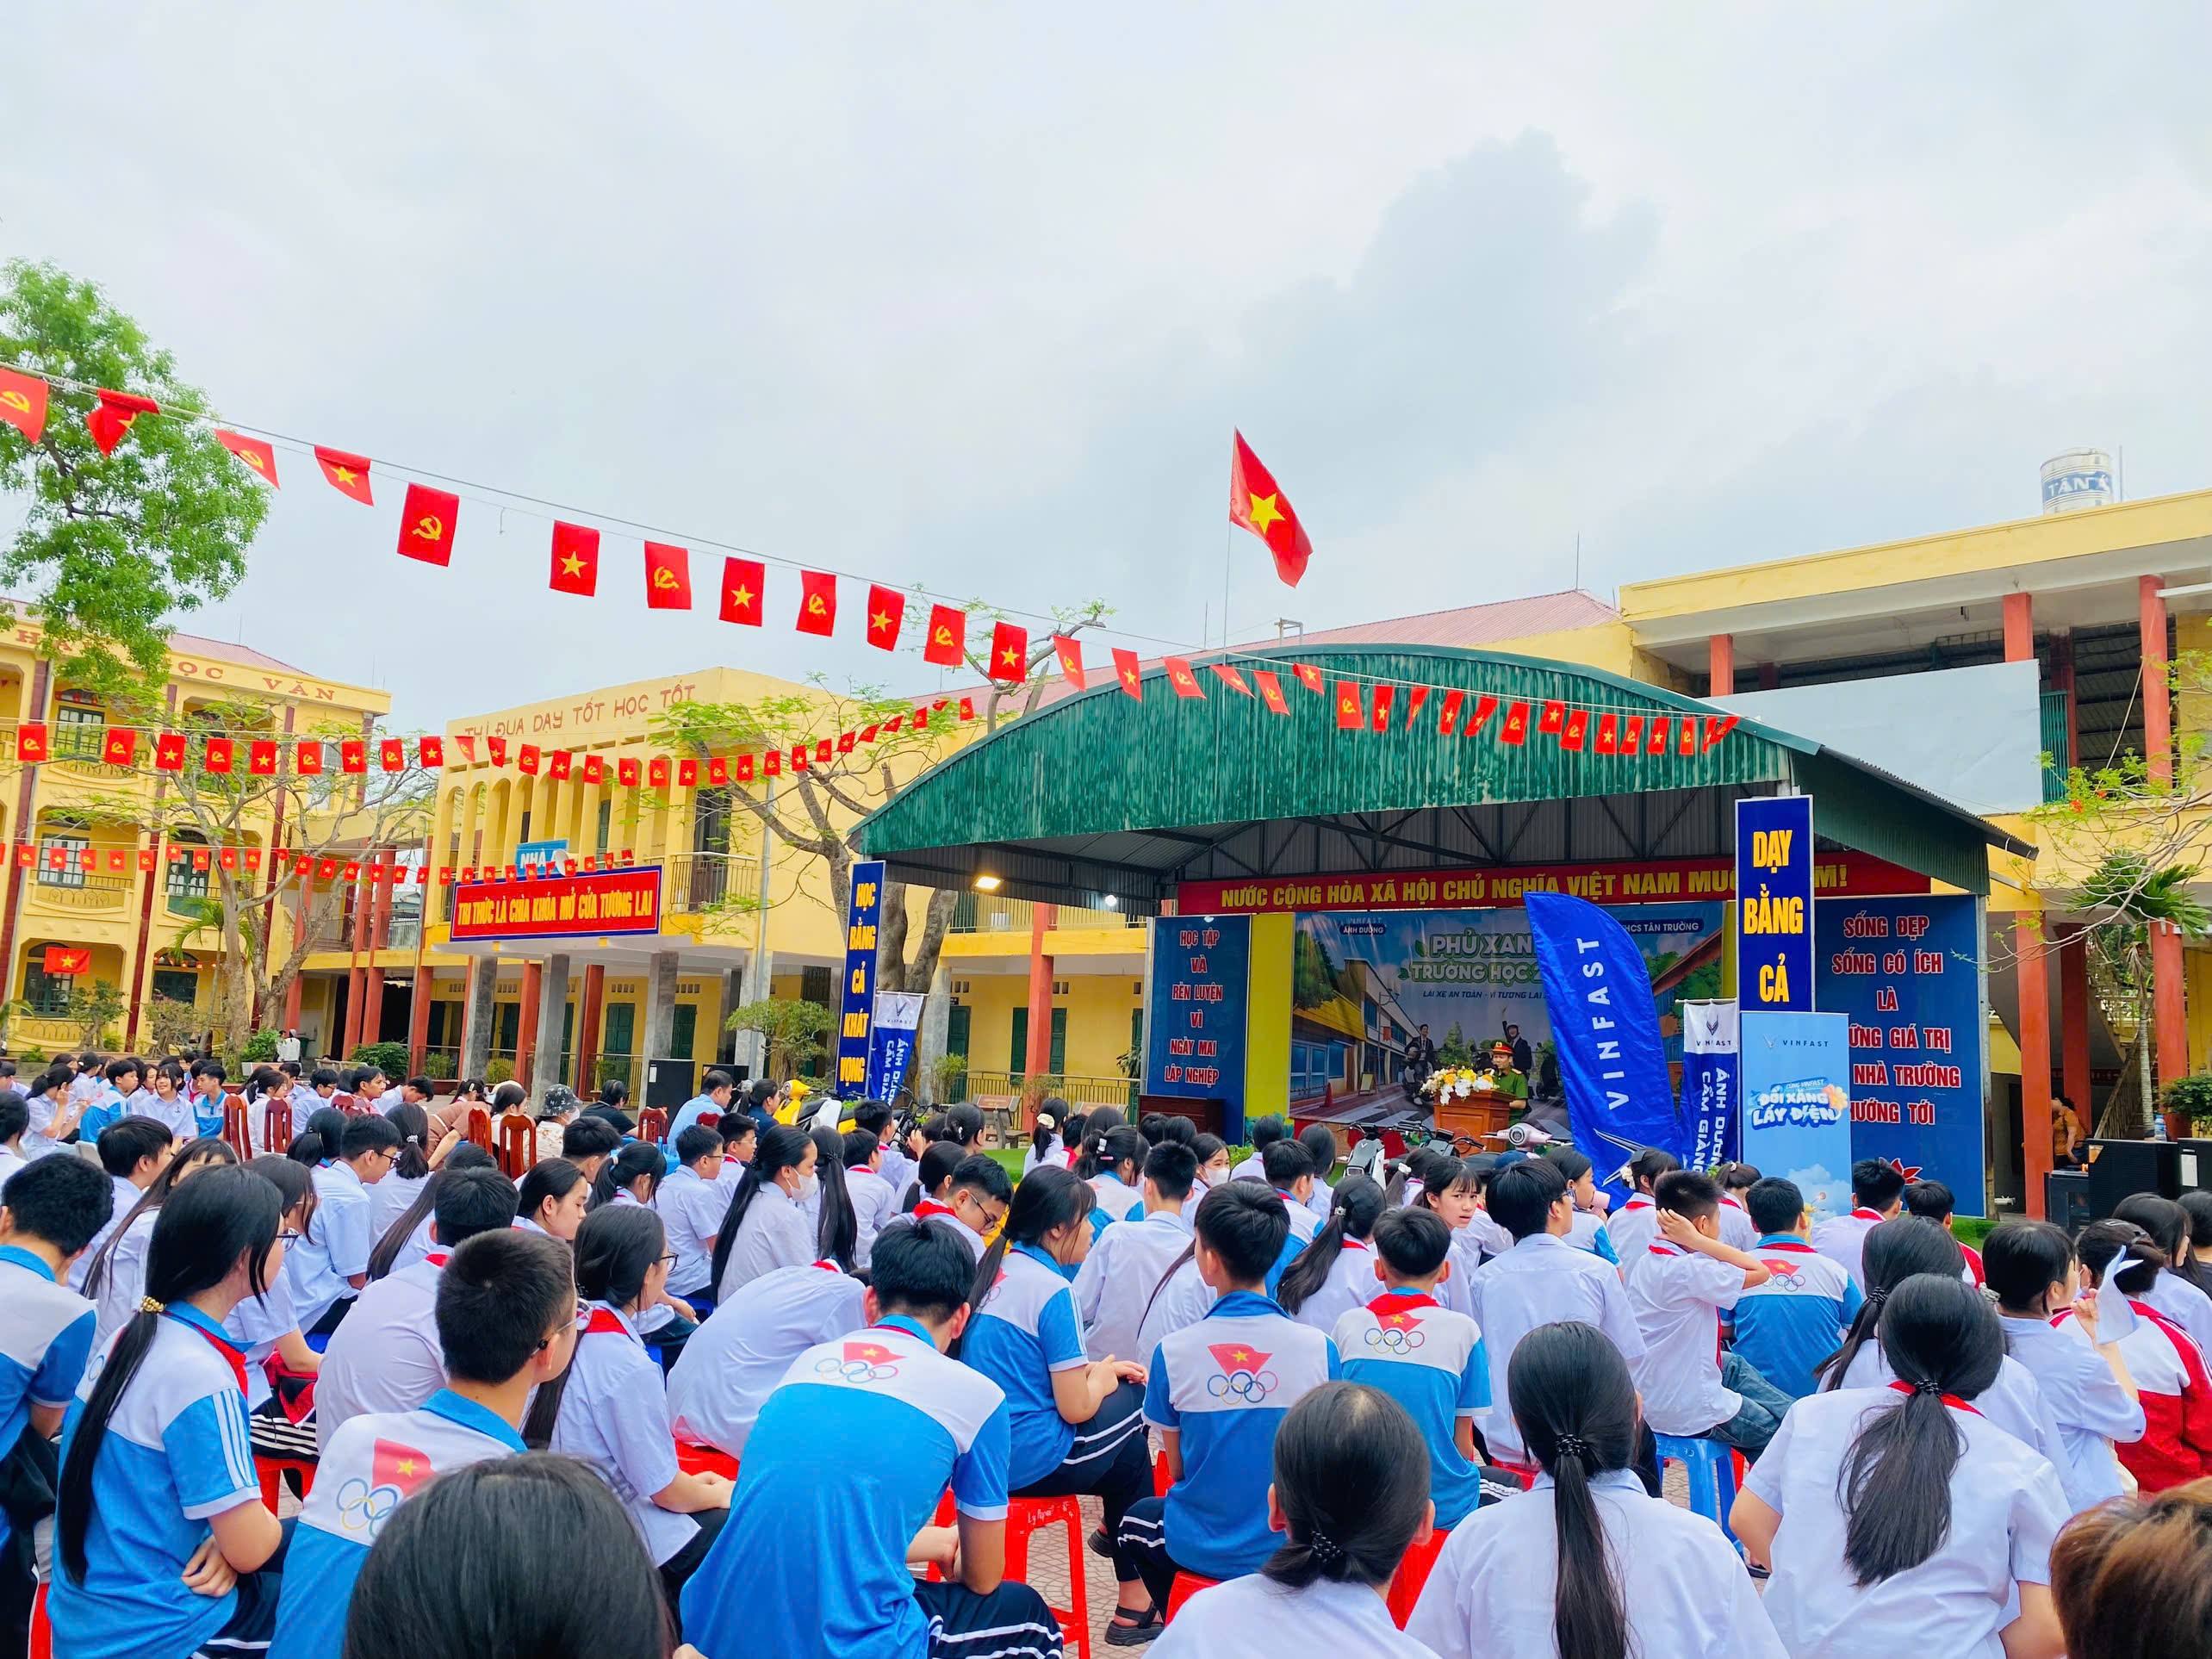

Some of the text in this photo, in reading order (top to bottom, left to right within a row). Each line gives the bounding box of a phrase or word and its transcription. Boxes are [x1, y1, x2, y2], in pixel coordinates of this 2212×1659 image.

[177, 661, 335, 701] ỌC VĂN
[495, 717, 525, 737] ĐUA
[532, 711, 563, 733] DẠY
[572, 696, 606, 725] TỐT
[613, 694, 649, 720] HỌC
[660, 679, 696, 708] TỐT
[519, 848, 546, 868] NHÀ
[1752, 830, 1793, 873] DẠY
[855, 882, 877, 911] HỌC
[1221, 885, 1269, 908] NƯỚC
[1273, 883, 1322, 910] CỘNG
[1327, 879, 1366, 904] HÒA
[1370, 879, 1397, 903] XÃ
[1402, 877, 1437, 905] HỘI
[1443, 873, 1485, 901] CHỦ
[1491, 873, 1560, 899] NGHĨA
[1566, 870, 1617, 901] VIỆT
[1623, 872, 1680, 895] NAM
[1687, 867, 1737, 893] MU
[457, 885, 653, 925] TRI THỨC LÀ CHÌA KHÓA MỞ CỬA TƯƠNG LAI
[1743, 883, 1804, 935] BẰNG
[848, 916, 876, 951] BẰNG
[1179, 927, 1220, 949] HỌC TẬP
[1623, 921, 1699, 932] HCS TÂN TRƯỜNG
[1843, 910, 1929, 941] SỐNG ĐẸP
[1432, 929, 1533, 954] PHỦ XAN
[1190, 954, 1208, 973] VÀ
[1411, 959, 1485, 980] TRƯỜNG
[1490, 963, 1529, 985] HỌC
[1831, 947, 1944, 974] SỐNG CÓ ÍCH
[851, 960, 867, 994] CẢ
[1759, 953, 1790, 1003] CẢ
[1171, 981, 1223, 1003] RÈN LUYỆN
[1876, 986, 1899, 1011] LÀ
[842, 1008, 869, 1038] KHÁT
[1190, 1009, 1203, 1028] VÌ
[1575, 937, 1630, 1110] VINFAST
[894, 1037, 909, 1066] ÁNH
[1170, 1035, 1217, 1057] NGÀY MAI
[1849, 1022, 1952, 1053] ỮNG GIÁ TRỊ
[839, 1056, 866, 1087] VỌNG
[1185, 1065, 1220, 1088] NGHIỆP
[1853, 1059, 1962, 1088] NHÀ TRƯỜNG
[1786, 1089, 1829, 1104] XĂNG
[1711, 1067, 1730, 1167] ÁNH DƯƠN
[1752, 1103, 1787, 1126] LẤY
[1907, 1099, 1936, 1125] TỚI
